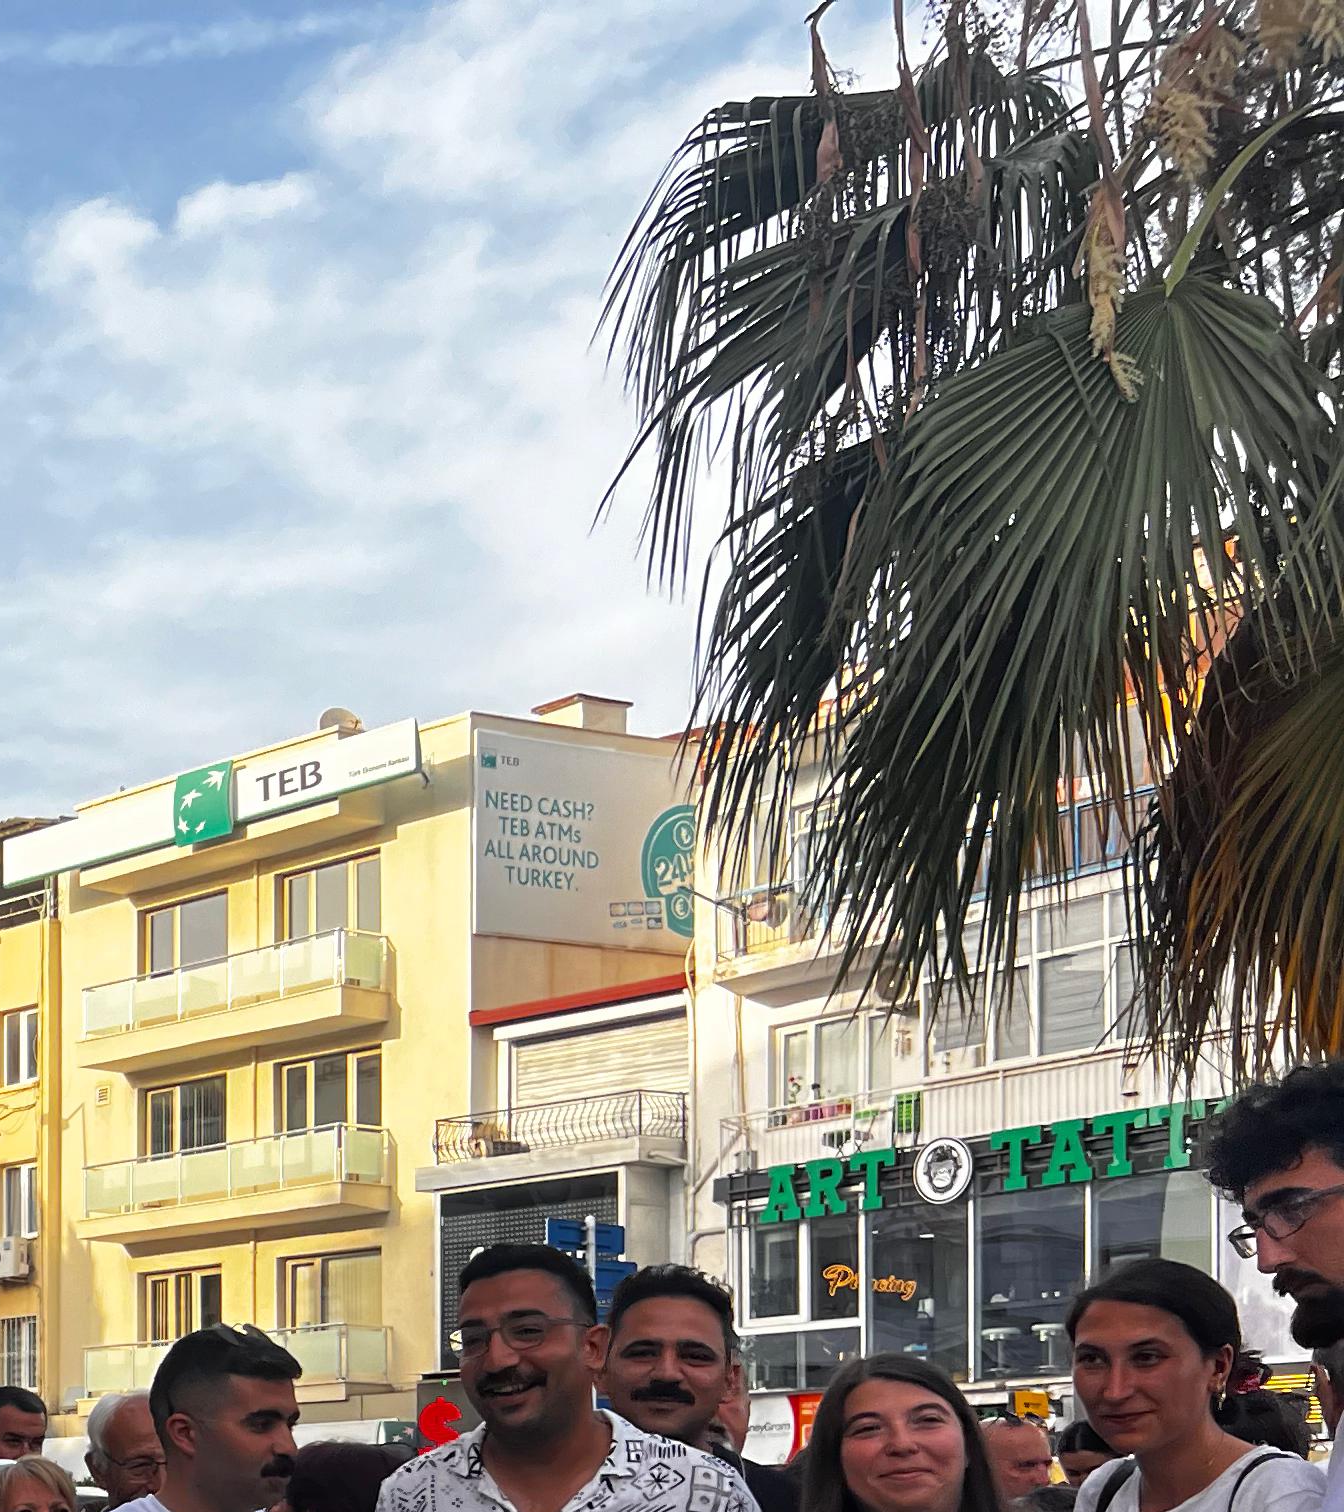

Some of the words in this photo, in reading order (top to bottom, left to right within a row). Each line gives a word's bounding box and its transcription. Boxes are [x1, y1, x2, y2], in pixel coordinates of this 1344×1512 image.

[500, 755, 520, 767] TEB
[255, 760, 323, 802] TEB
[484, 789, 533, 813] NEED
[538, 797, 595, 822] CASH?
[499, 815, 530, 838] TEB
[535, 821, 582, 844] ATMs
[484, 839, 514, 860] ALL
[519, 844, 600, 869] AROUND
[504, 865, 580, 892] TURKEY.
[990, 1096, 1230, 1192] TATT
[759, 1146, 897, 1224] ART
[750, 1421, 791, 1433] neyGram
